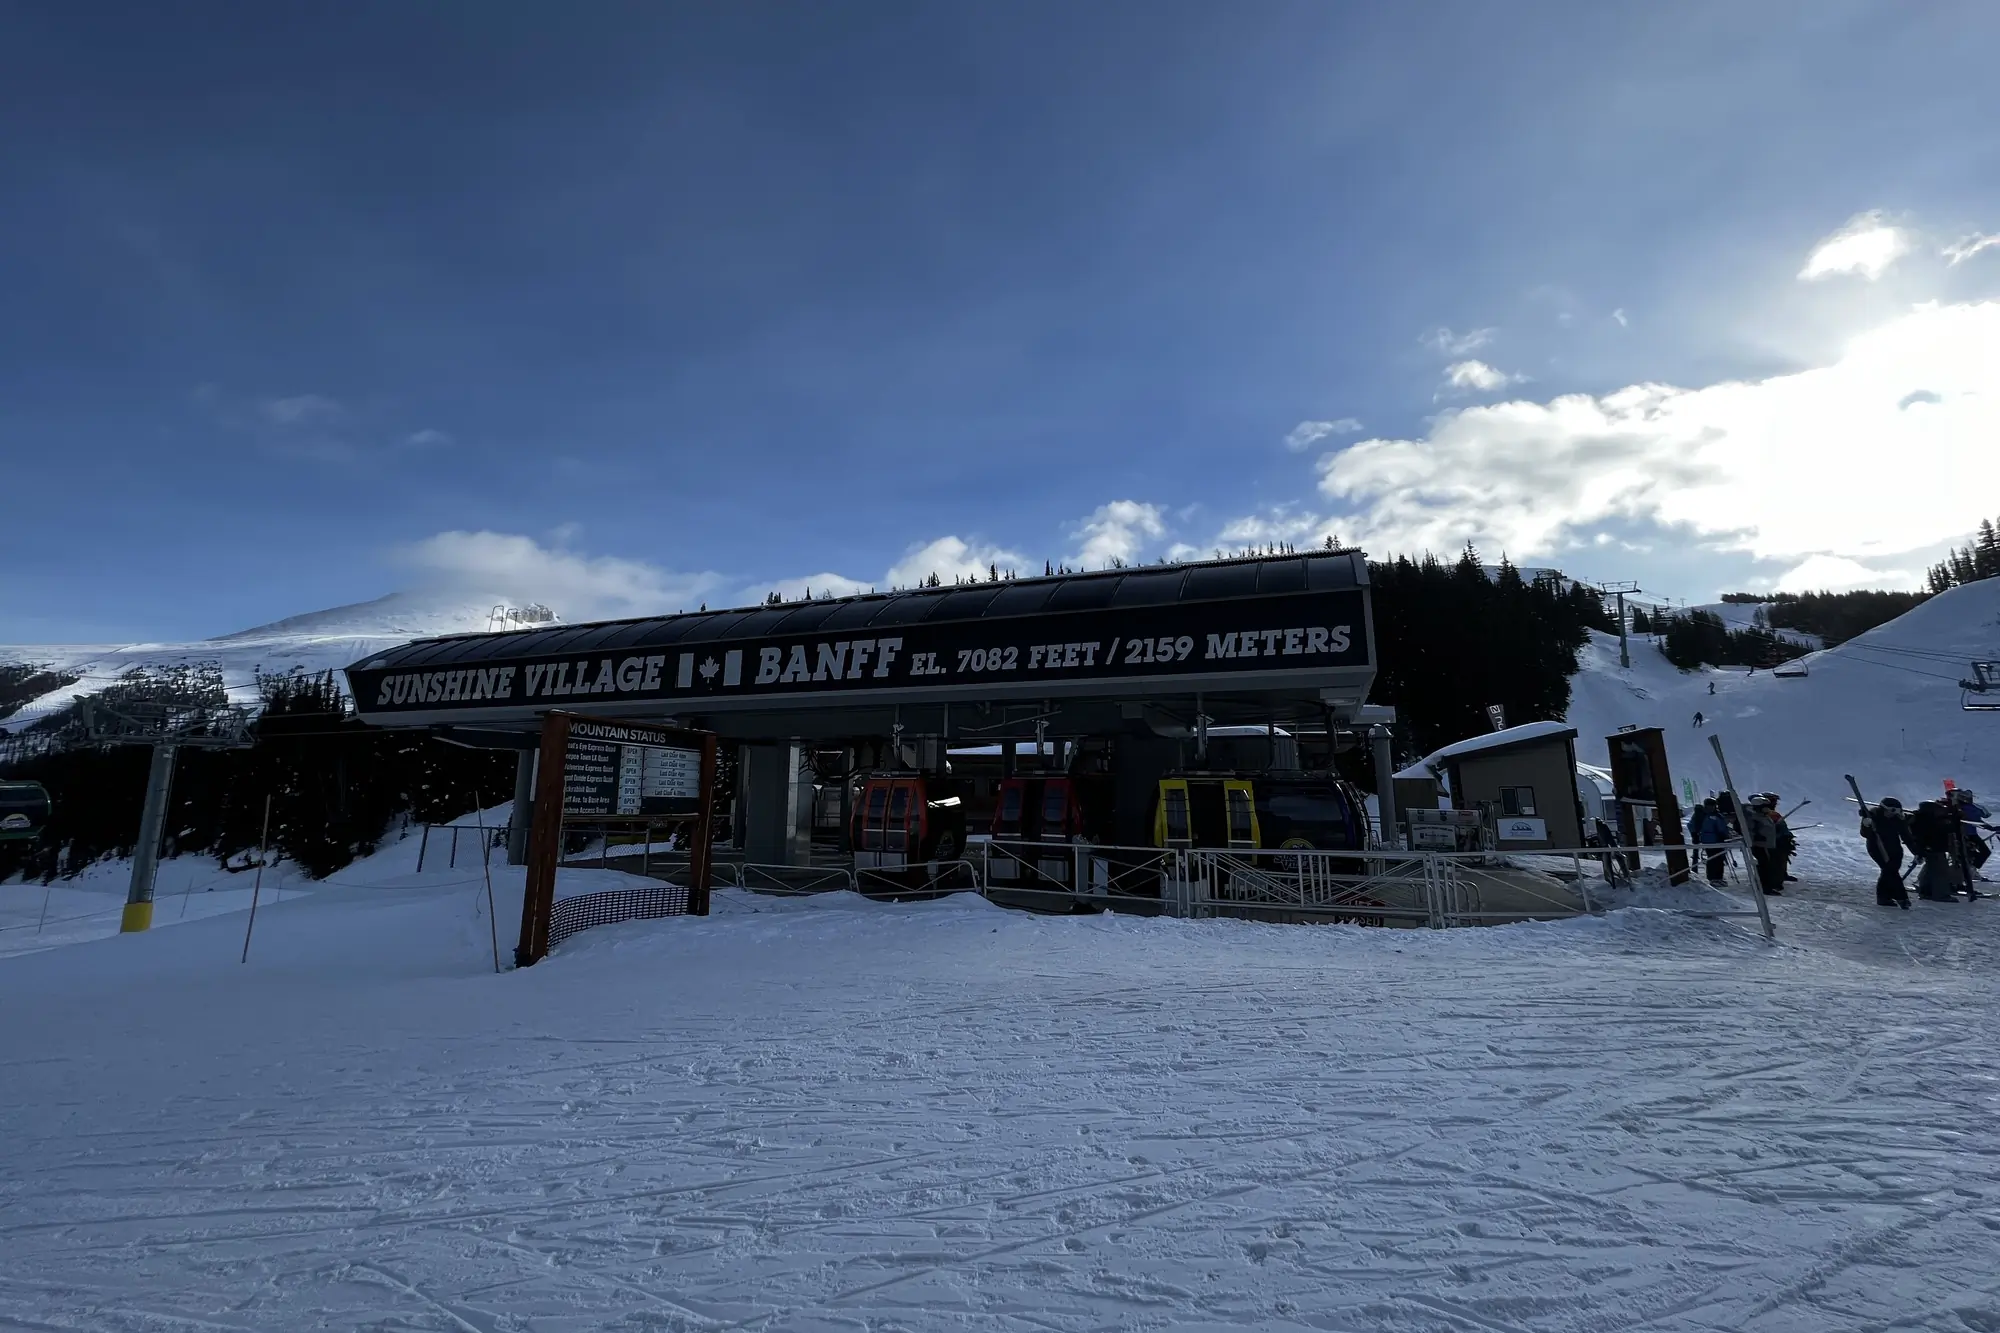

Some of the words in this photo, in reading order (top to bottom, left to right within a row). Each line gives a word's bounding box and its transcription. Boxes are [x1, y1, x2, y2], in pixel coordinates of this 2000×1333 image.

[377, 667, 515, 705] SUNSHINE
[525, 655, 665, 696] VILLAGE
[754, 637, 903, 684] BANFF
[910, 653, 946, 675] EL.
[957, 647, 1018, 672] 7082
[1028, 642, 1100, 668] FEET
[1105, 637, 1120, 665] /
[1125, 635, 1194, 663] 2159
[1205, 625, 1351, 659] METERS
[569, 722, 628, 740] MOUNTAIN
[630, 729, 666, 743] STATUS
